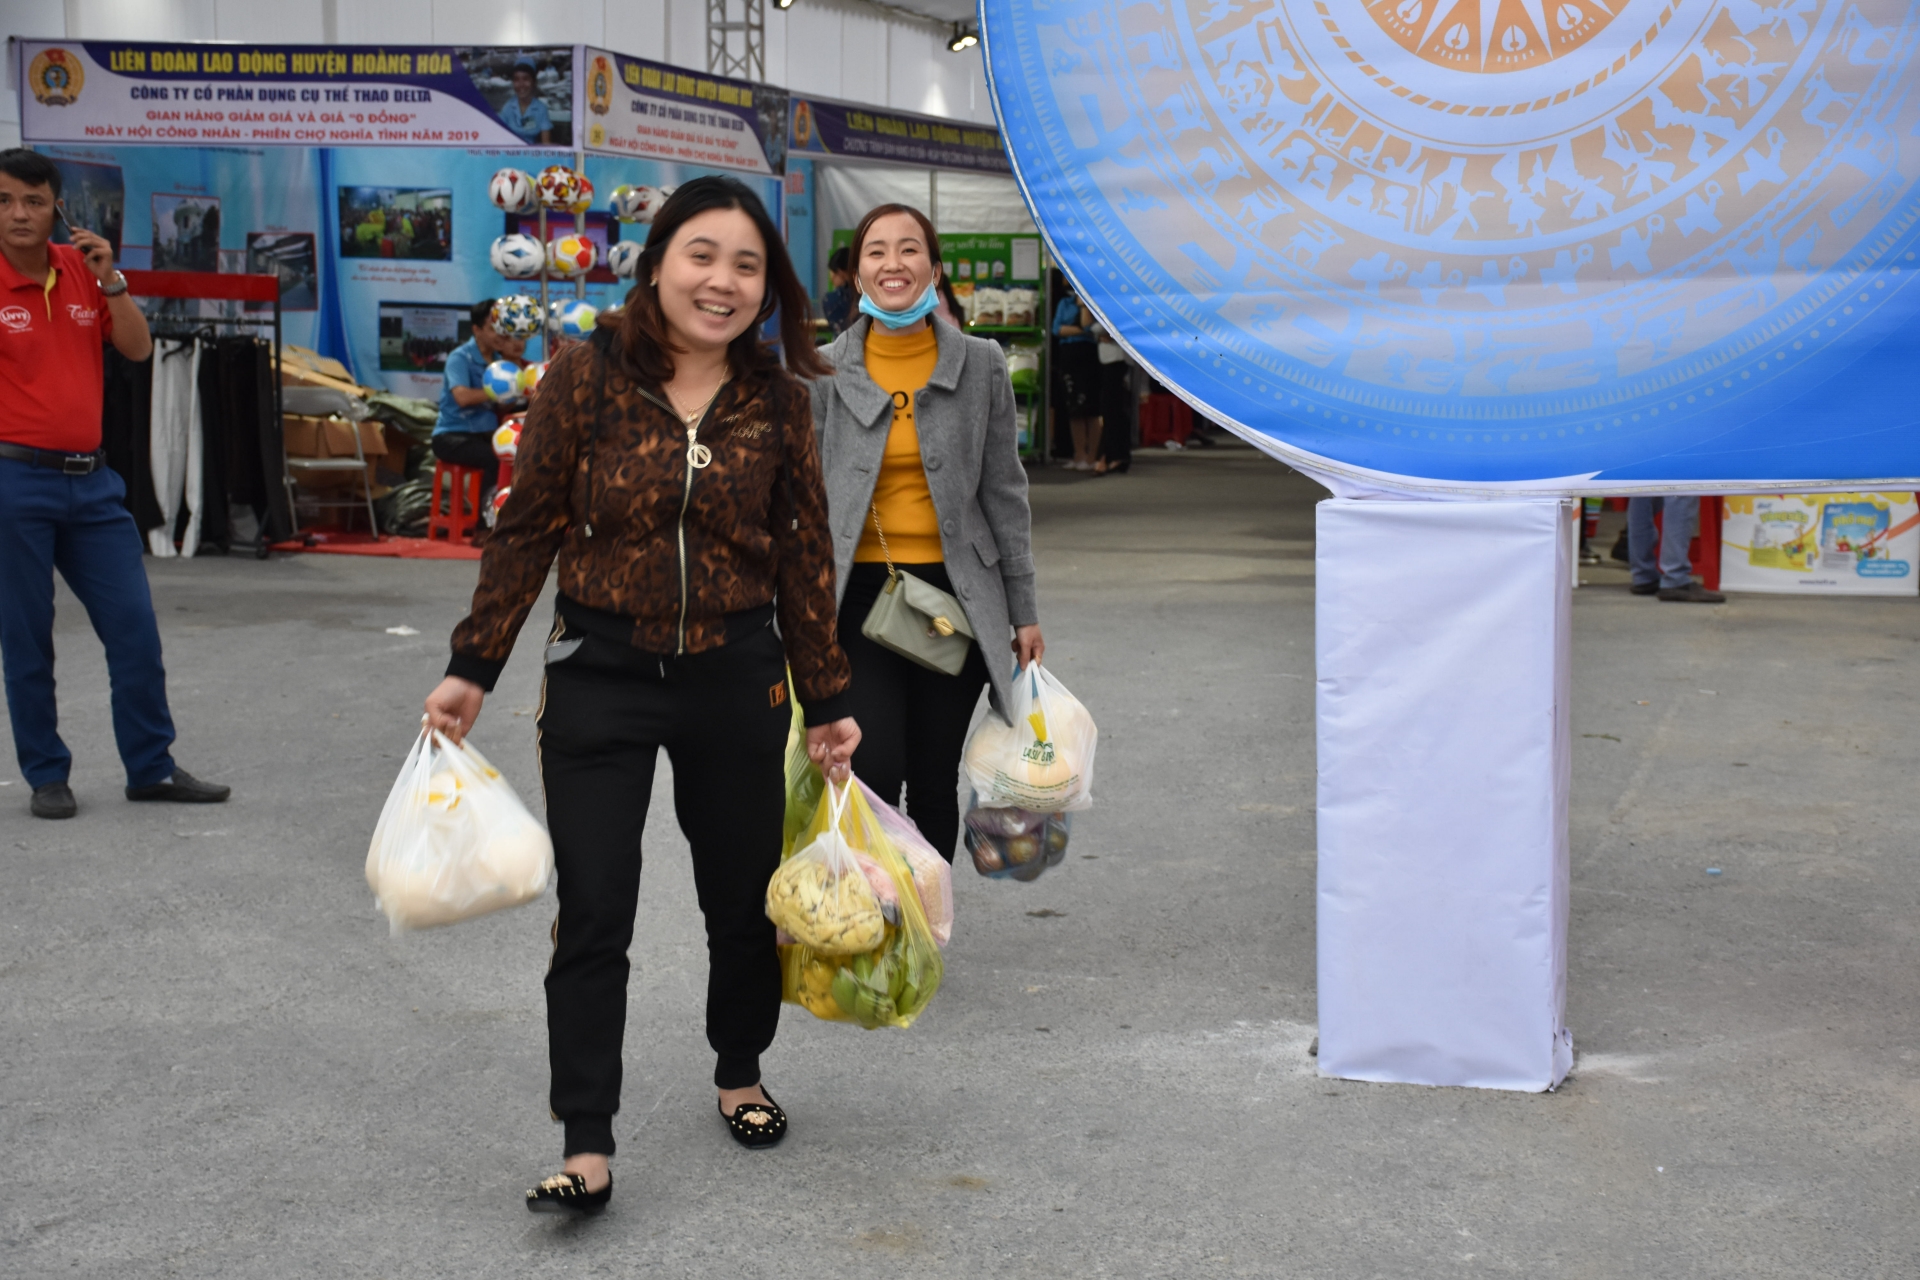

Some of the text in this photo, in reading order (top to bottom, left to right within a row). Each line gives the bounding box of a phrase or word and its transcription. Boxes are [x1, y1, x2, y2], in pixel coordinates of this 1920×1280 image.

[110, 47, 146, 72] LIÊN
[150, 49, 198, 73] ĐOÀN
[203, 52, 233, 73] LAO
[238, 49, 287, 77] ĐỘNG
[291, 50, 347, 77] HUYỆN
[416, 51, 452, 74] HÓA
[130, 84, 168, 100] CÔNG
[173, 87, 189, 100] TY
[258, 89, 296, 103] DỤNG
[301, 89, 319, 104] CỤ
[354, 89, 388, 102] THAO
[394, 89, 432, 102] DELTA
[146, 110, 181, 121] GIAN
[185, 109, 224, 121] HÀNG
[228, 109, 264, 122] GIẢM
[268, 110, 293, 122] GIÁ
[297, 110, 316, 123] VÀ
[320, 110, 345, 123] GIÁ
[85, 125, 123, 136] NGÀY
[127, 125, 152, 138] HỘI
[156, 125, 198, 138] CÔNG
[202, 126, 240, 138] NHÂN
[252, 127, 290, 139] PHIÊN
[295, 129, 326, 142] CHỢ
[330, 129, 374, 140] NGHĨA
[378, 129, 408, 140] TÌNH
[412, 129, 443, 141] NĂM
[447, 131, 480, 141] 2019
